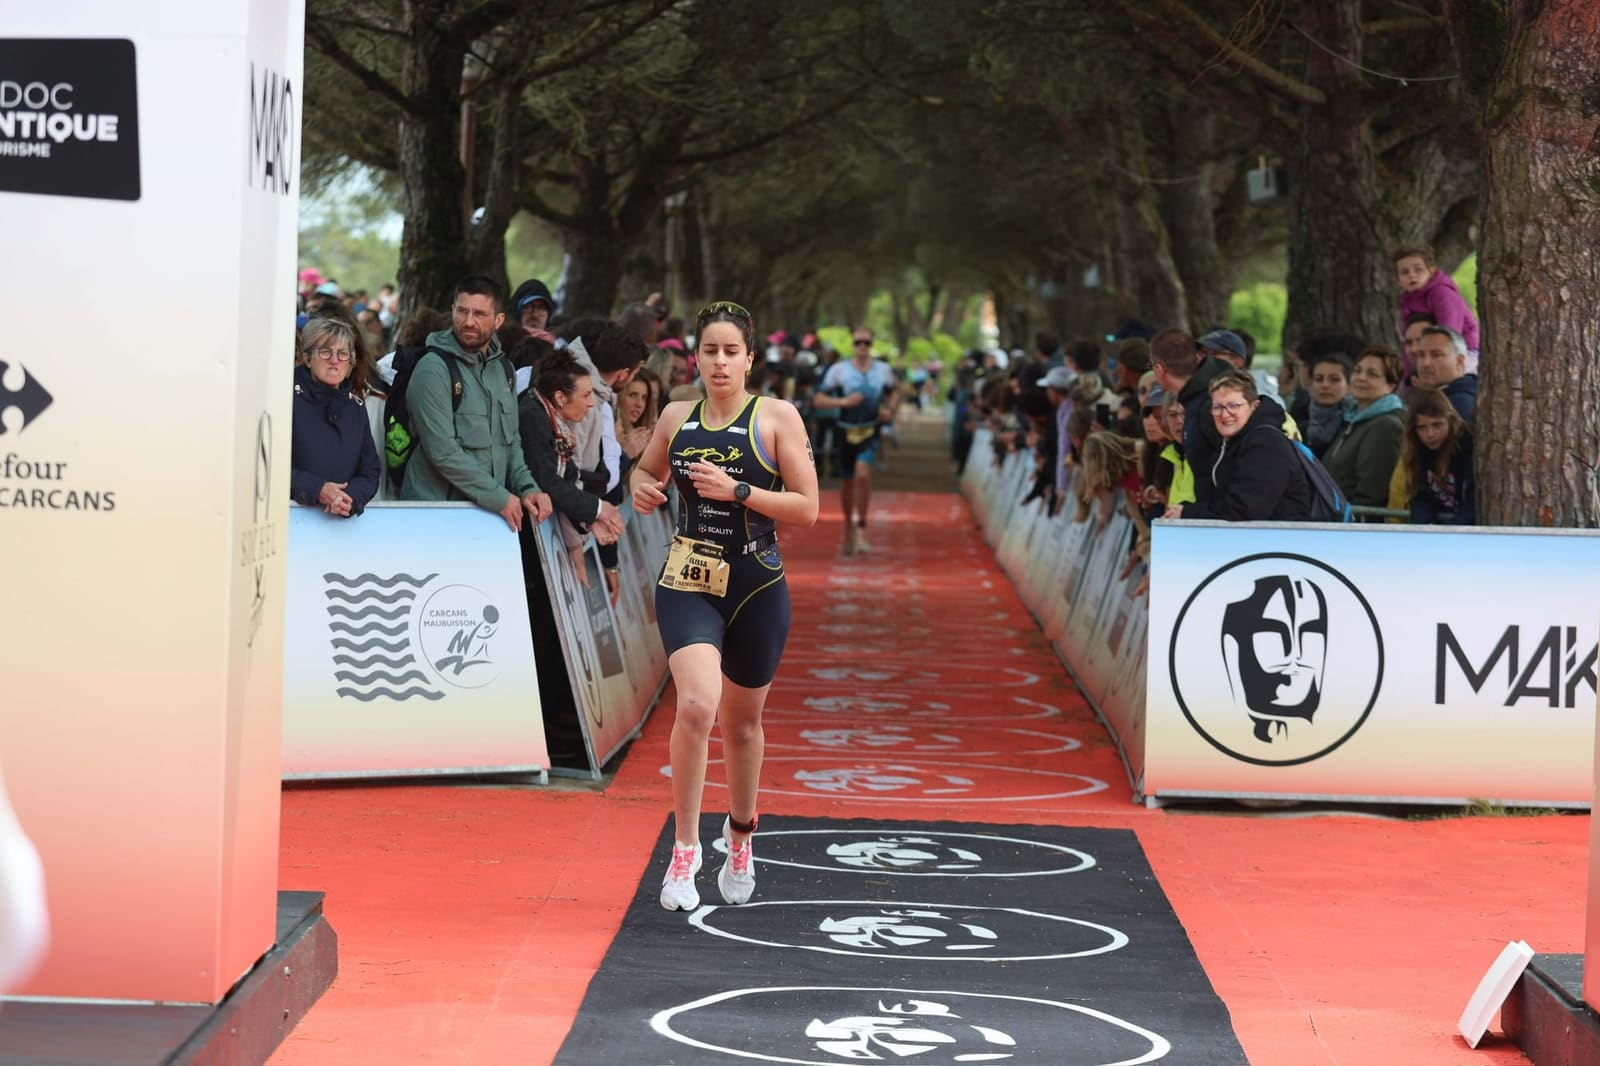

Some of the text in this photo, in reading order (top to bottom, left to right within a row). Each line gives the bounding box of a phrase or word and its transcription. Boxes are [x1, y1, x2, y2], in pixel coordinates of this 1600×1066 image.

[0, 453, 67, 480] four
[707, 526, 733, 535] SCALITY
[680, 564, 711, 584] 481
[429, 609, 468, 618] CARCANS
[423, 619, 477, 628] MAUBUISSON
